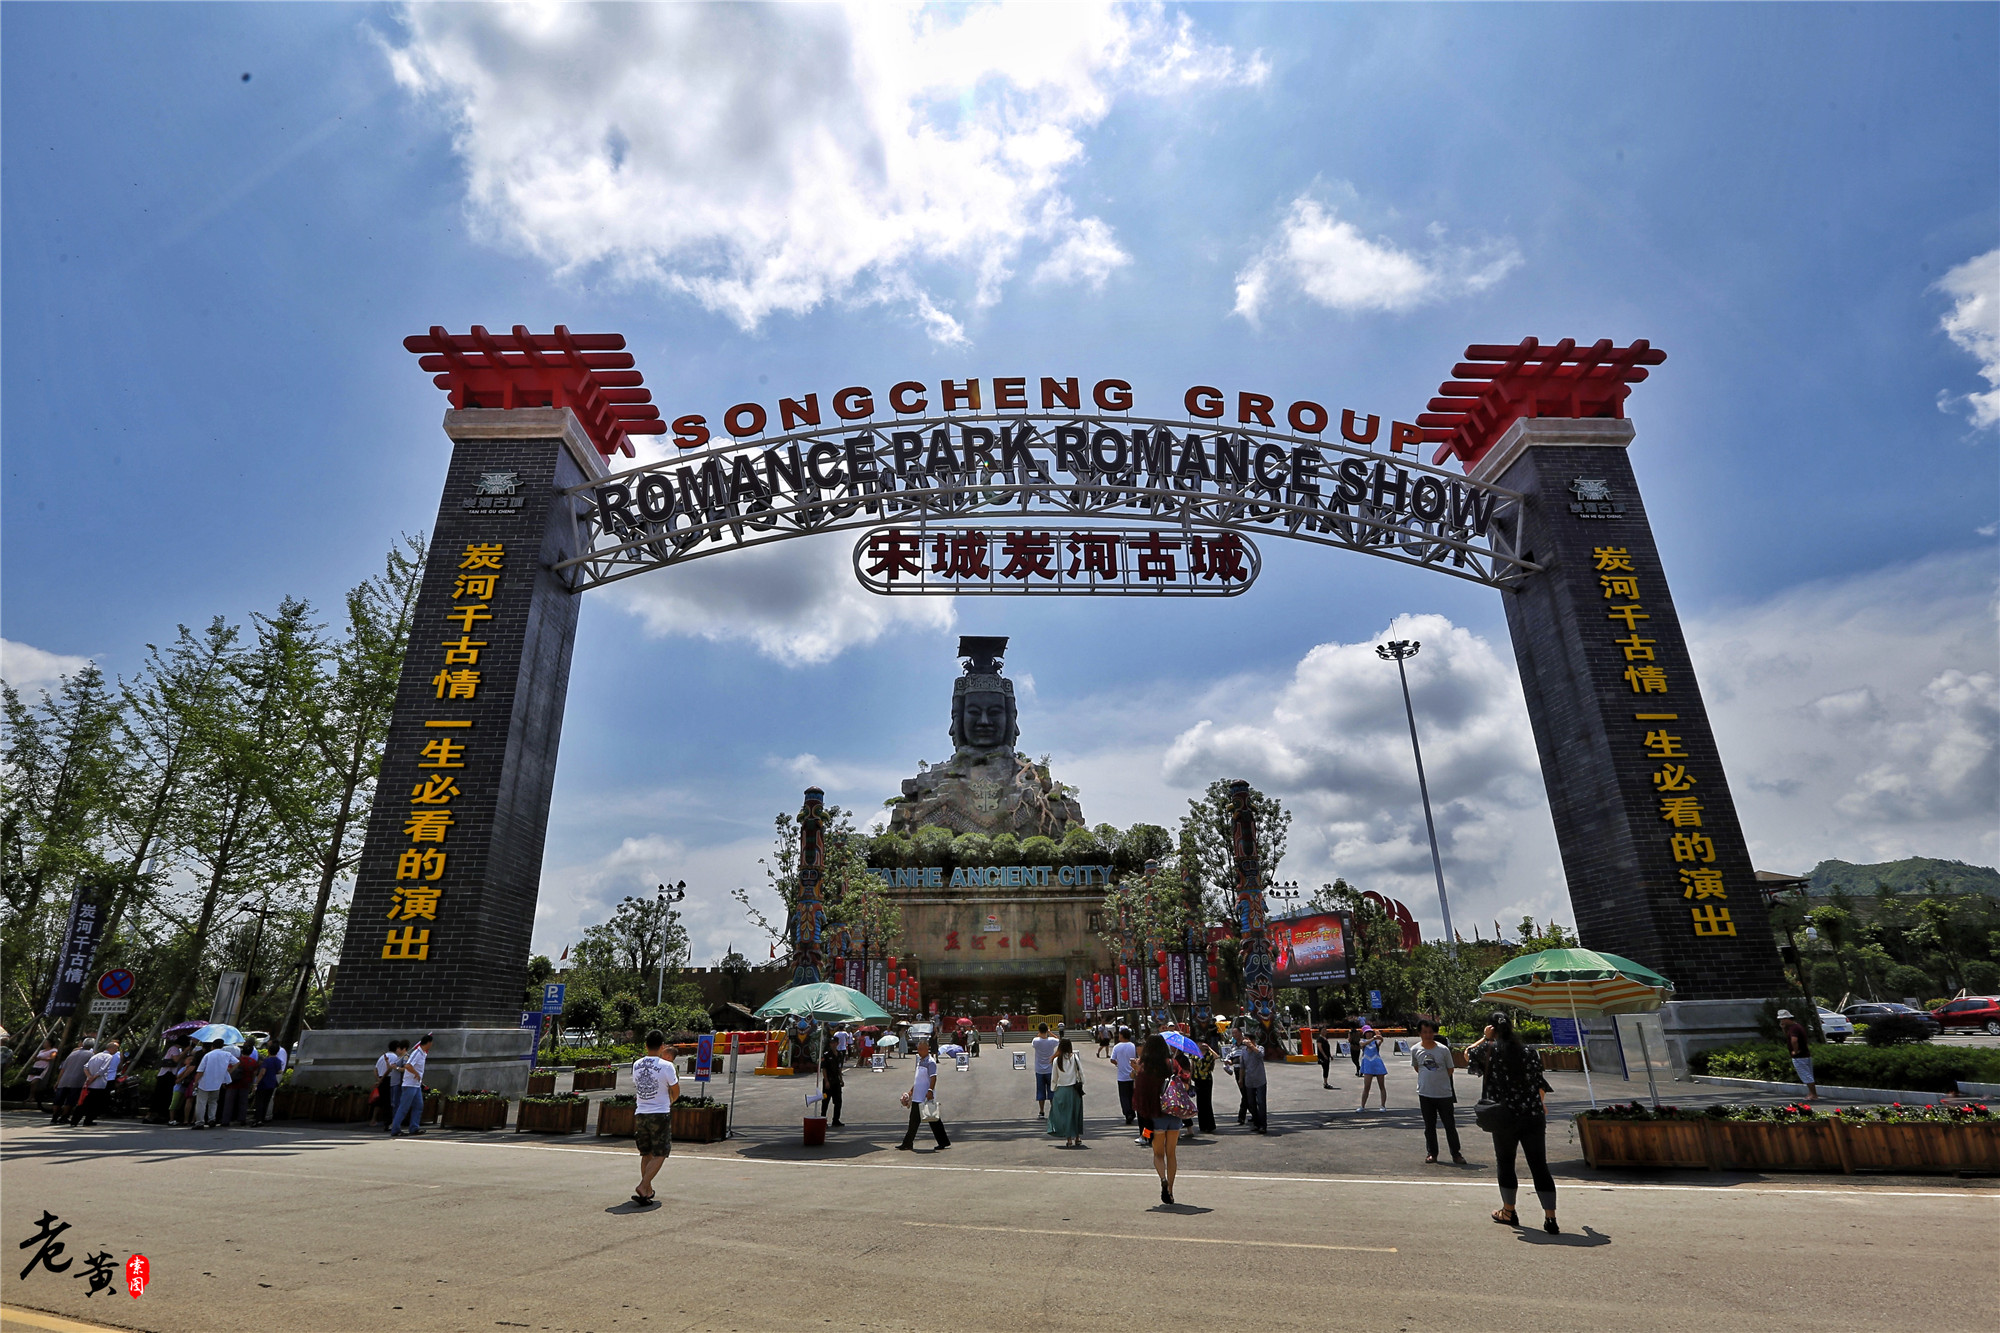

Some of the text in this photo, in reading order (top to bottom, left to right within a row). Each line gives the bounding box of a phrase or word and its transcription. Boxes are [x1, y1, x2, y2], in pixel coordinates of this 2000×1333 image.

[672, 377, 1425, 453] SONGCHENG GROUP
[594, 436, 879, 535] ROMANCE
[891, 426, 1038, 479] PARK
[1055, 426, 1320, 495] ROMANCE
[1336, 458, 1498, 536] SHOW
[866, 529, 1249, 582] 宋城炭河古城
[381, 543, 505, 961] 炭河千古情 一生必看的演出
[1593, 546, 1737, 937] 炭河千古情 一生必看的演出
[950, 866, 1052, 887] ANCIENT
[1058, 865, 1114, 886] CITY
[64, 904, 97, 983] 炭河千古情
[521, 1014, 529, 1025] P
[547, 986, 558, 998] P
